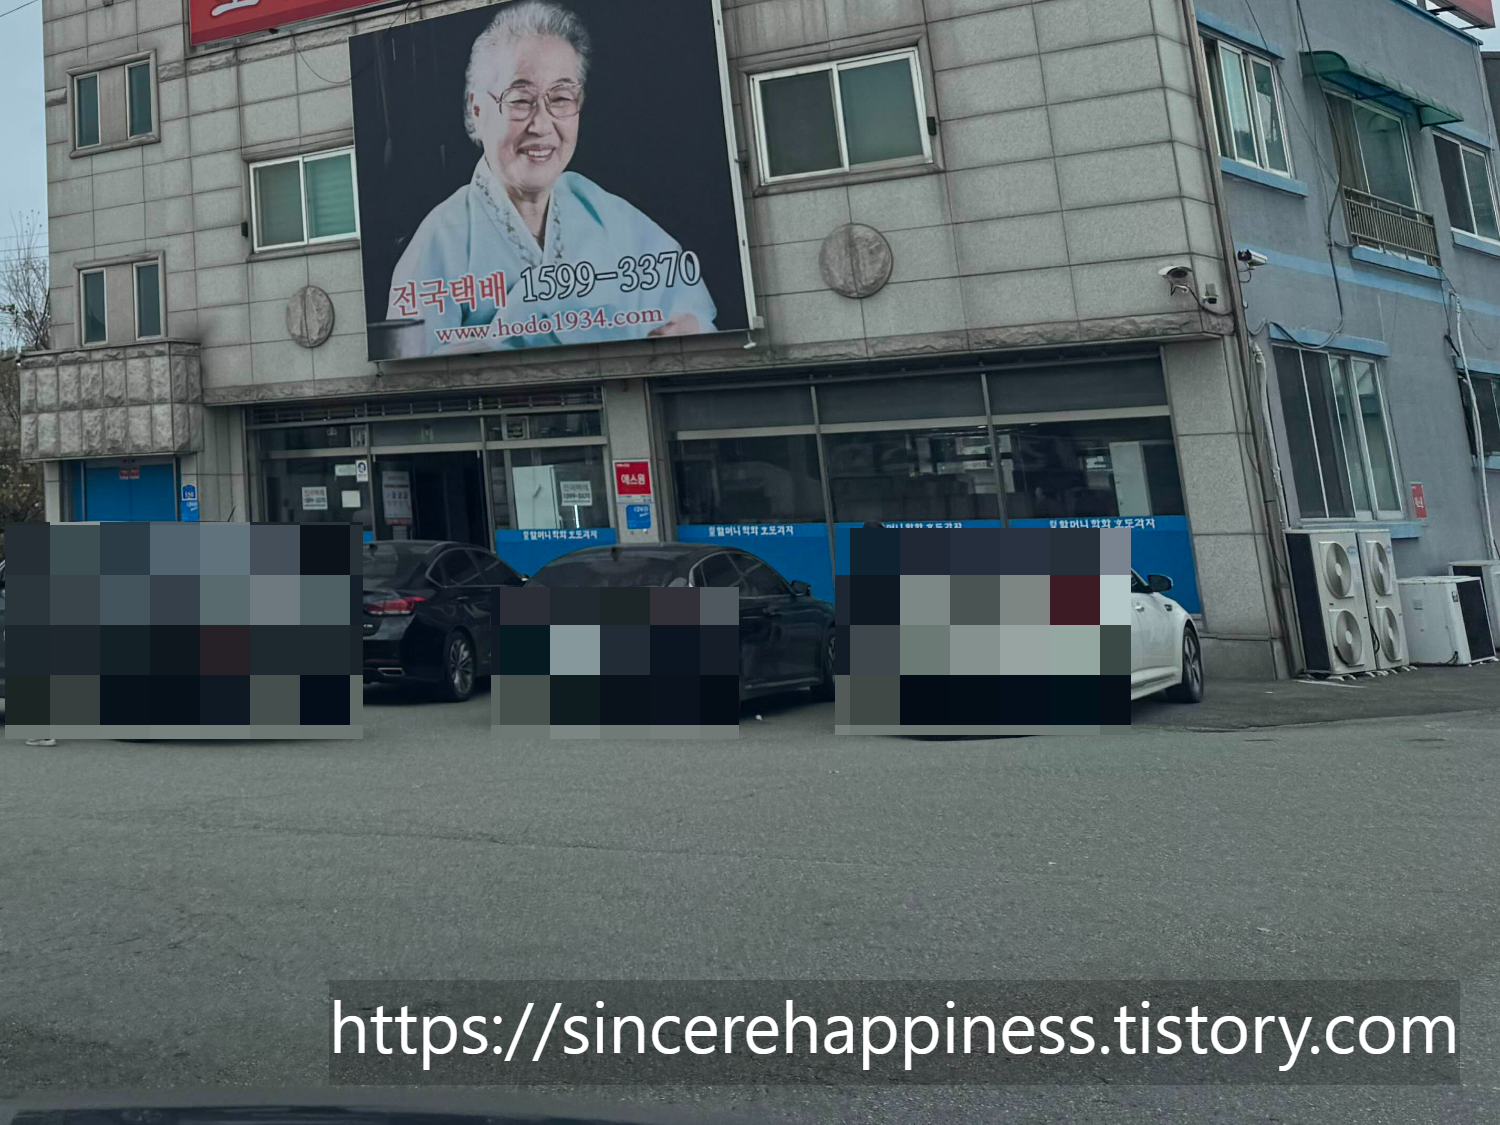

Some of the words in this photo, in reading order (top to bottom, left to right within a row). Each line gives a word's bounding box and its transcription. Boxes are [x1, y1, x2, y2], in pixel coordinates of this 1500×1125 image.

[391, 270, 508, 318] 전국택배
[520, 249, 701, 303] 1599-3370
[433, 308, 664, 345] www.hodo1934.com
